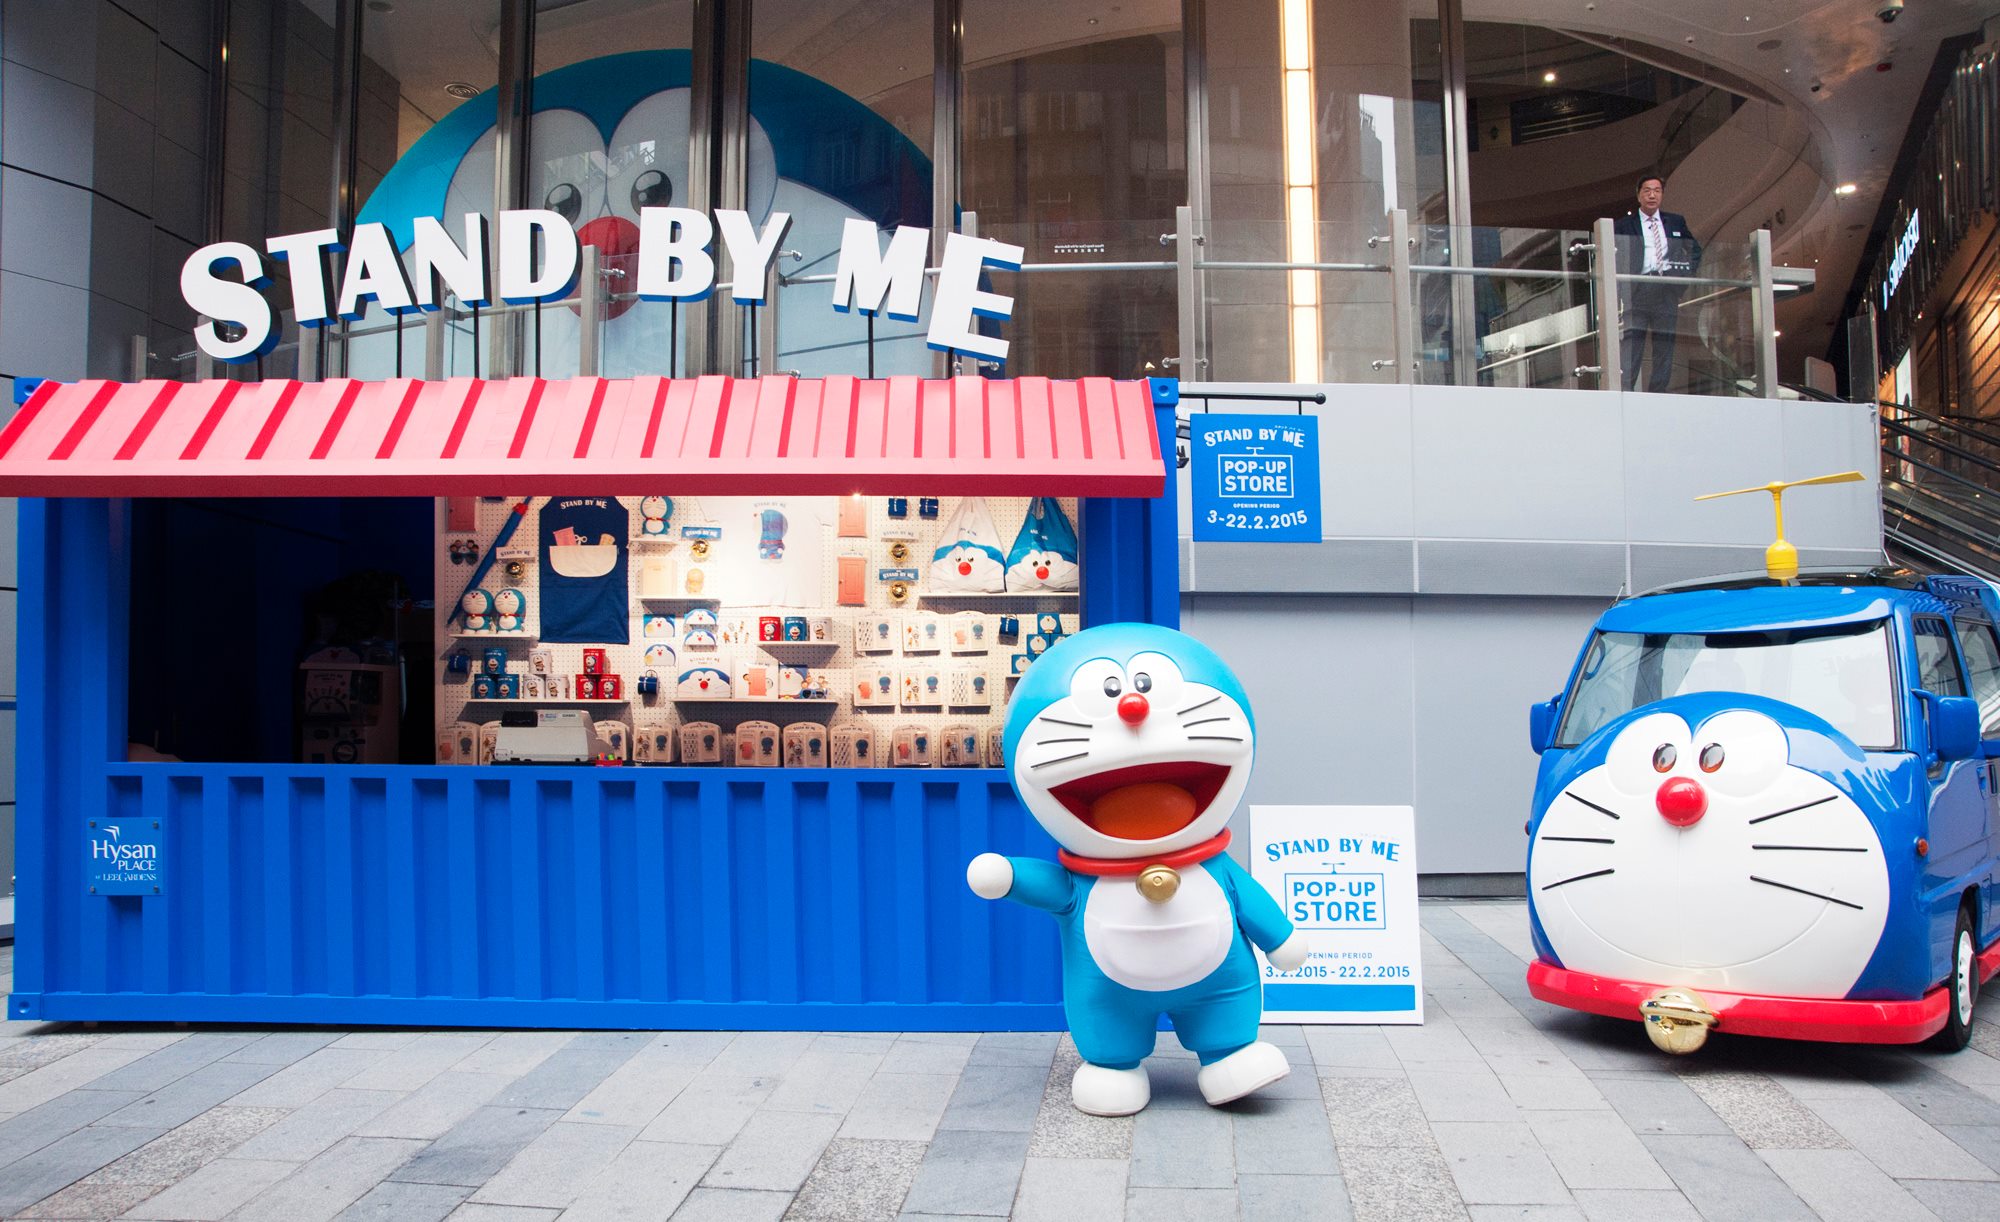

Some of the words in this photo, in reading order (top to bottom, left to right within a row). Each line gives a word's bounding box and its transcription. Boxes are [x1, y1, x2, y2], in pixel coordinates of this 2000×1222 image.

[180, 209, 580, 363] STAND
[637, 206, 792, 304] BY
[833, 218, 1026, 362] ME
[1204, 428, 1253, 447] STAND
[1259, 428, 1277, 441] BY
[1282, 430, 1305, 448] ME
[1224, 460, 1287, 473] POP-UP
[1224, 475, 1288, 492] STORE
[560, 500, 583, 510] STAND
[595, 500, 607, 510] ME
[1207, 509, 1307, 529] 3-22.2.2015
[91, 839, 156, 864] Hysan
[1265, 838, 1330, 862] STAND
[1339, 838, 1363, 853] BY
[1371, 840, 1400, 862] ME
[118, 860, 156, 871] PLACE
[1293, 881, 1376, 897] POP-UP
[1293, 901, 1377, 922] STORE
[1339, 966, 1410, 978] 22.2.2015
